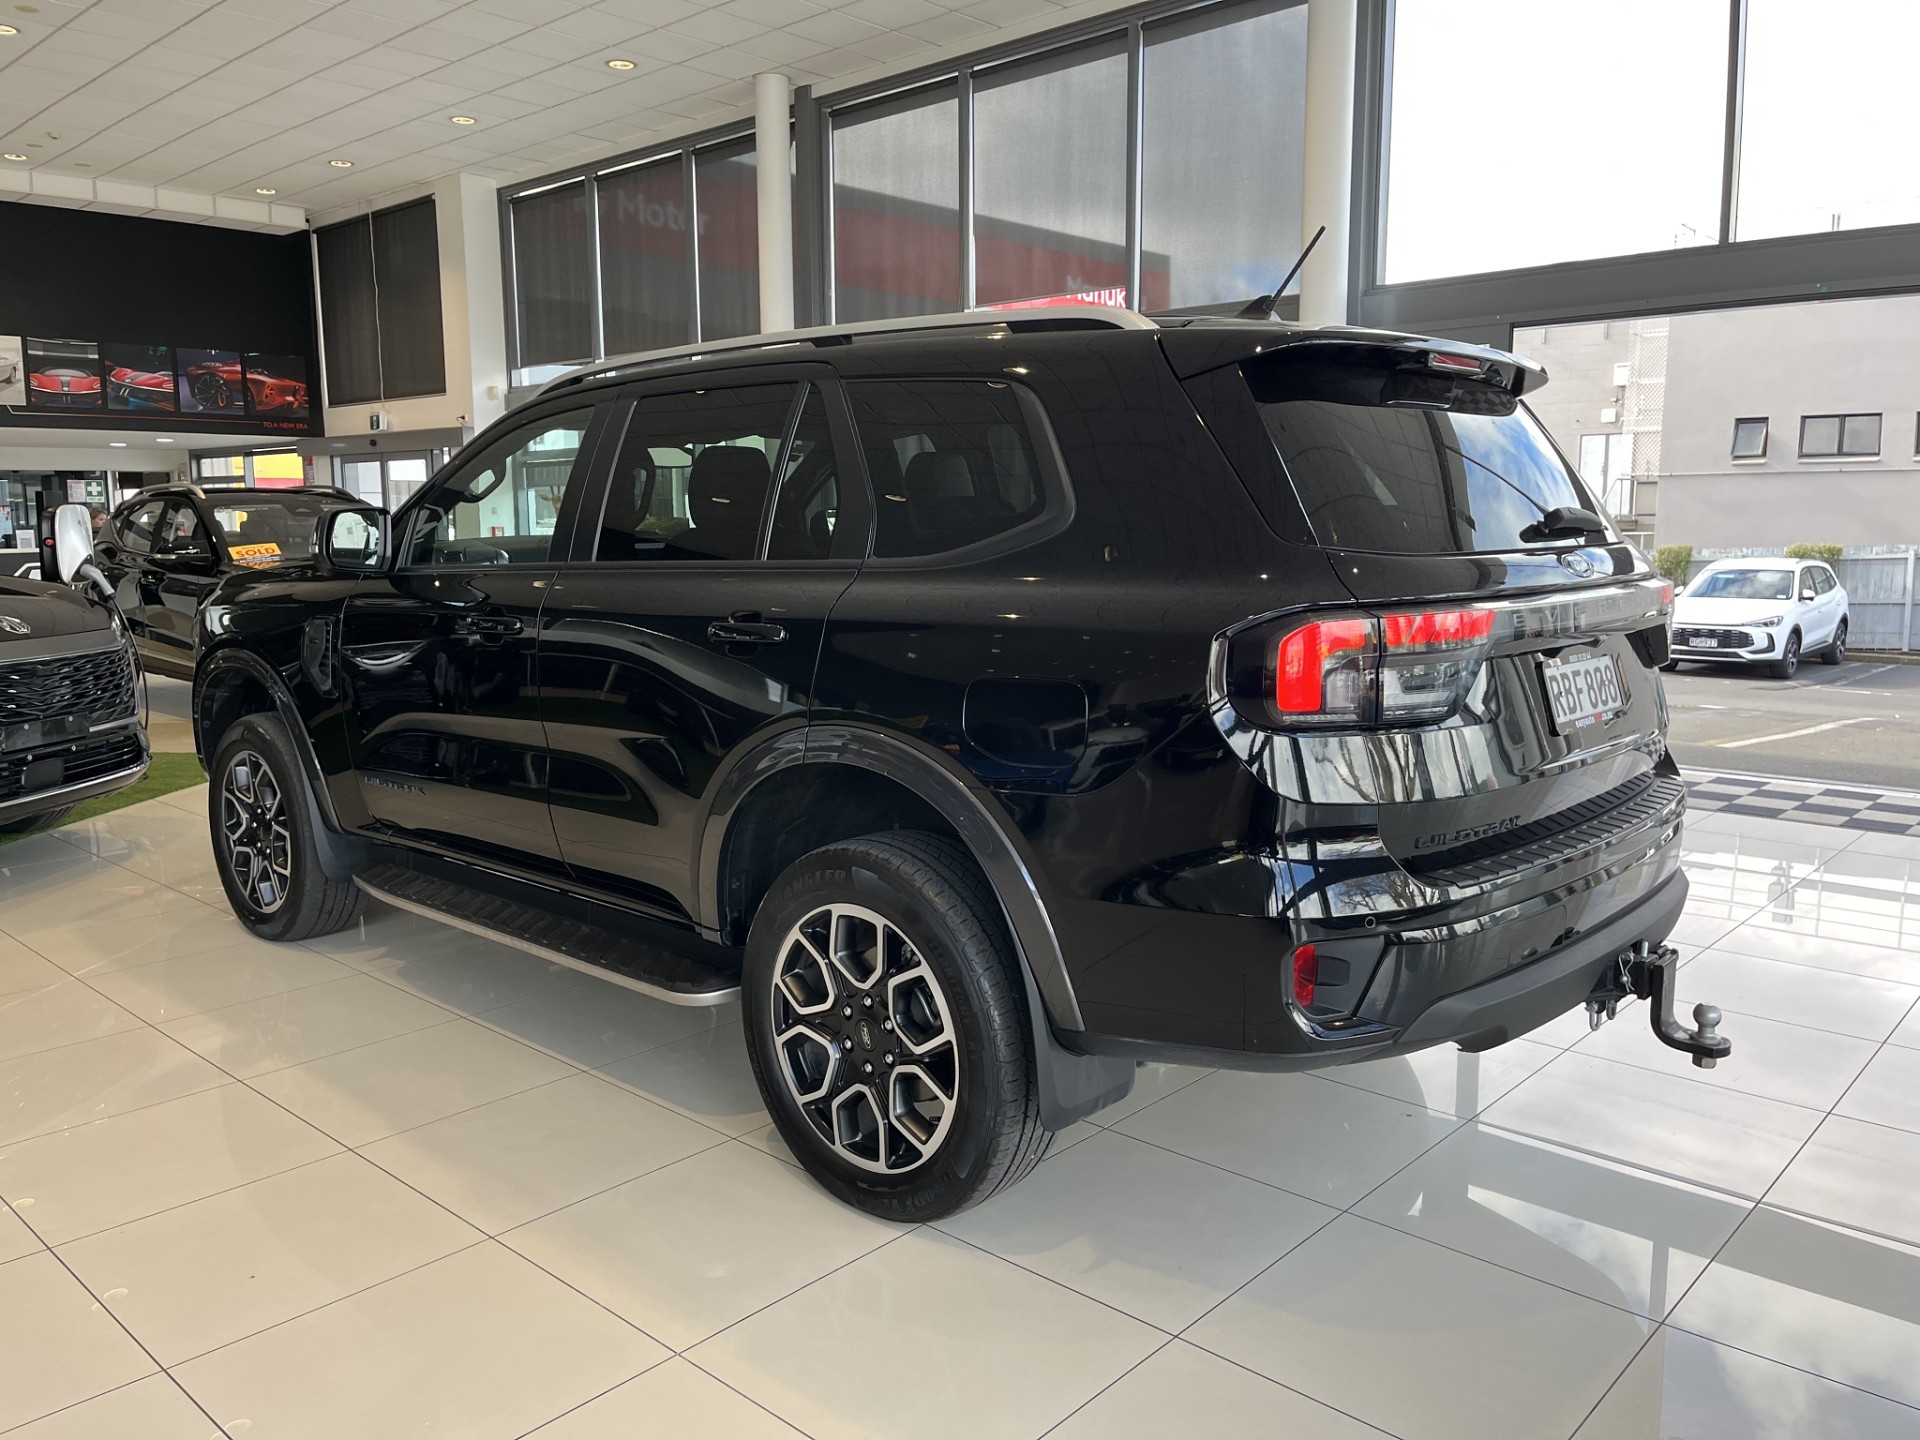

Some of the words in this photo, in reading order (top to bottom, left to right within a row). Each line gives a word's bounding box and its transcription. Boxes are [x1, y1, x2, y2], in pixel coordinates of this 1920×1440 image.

[1066, 276, 1146, 309] Manuk
[236, 547, 275, 557] SOLD
[1548, 664, 1618, 718] RBF808
